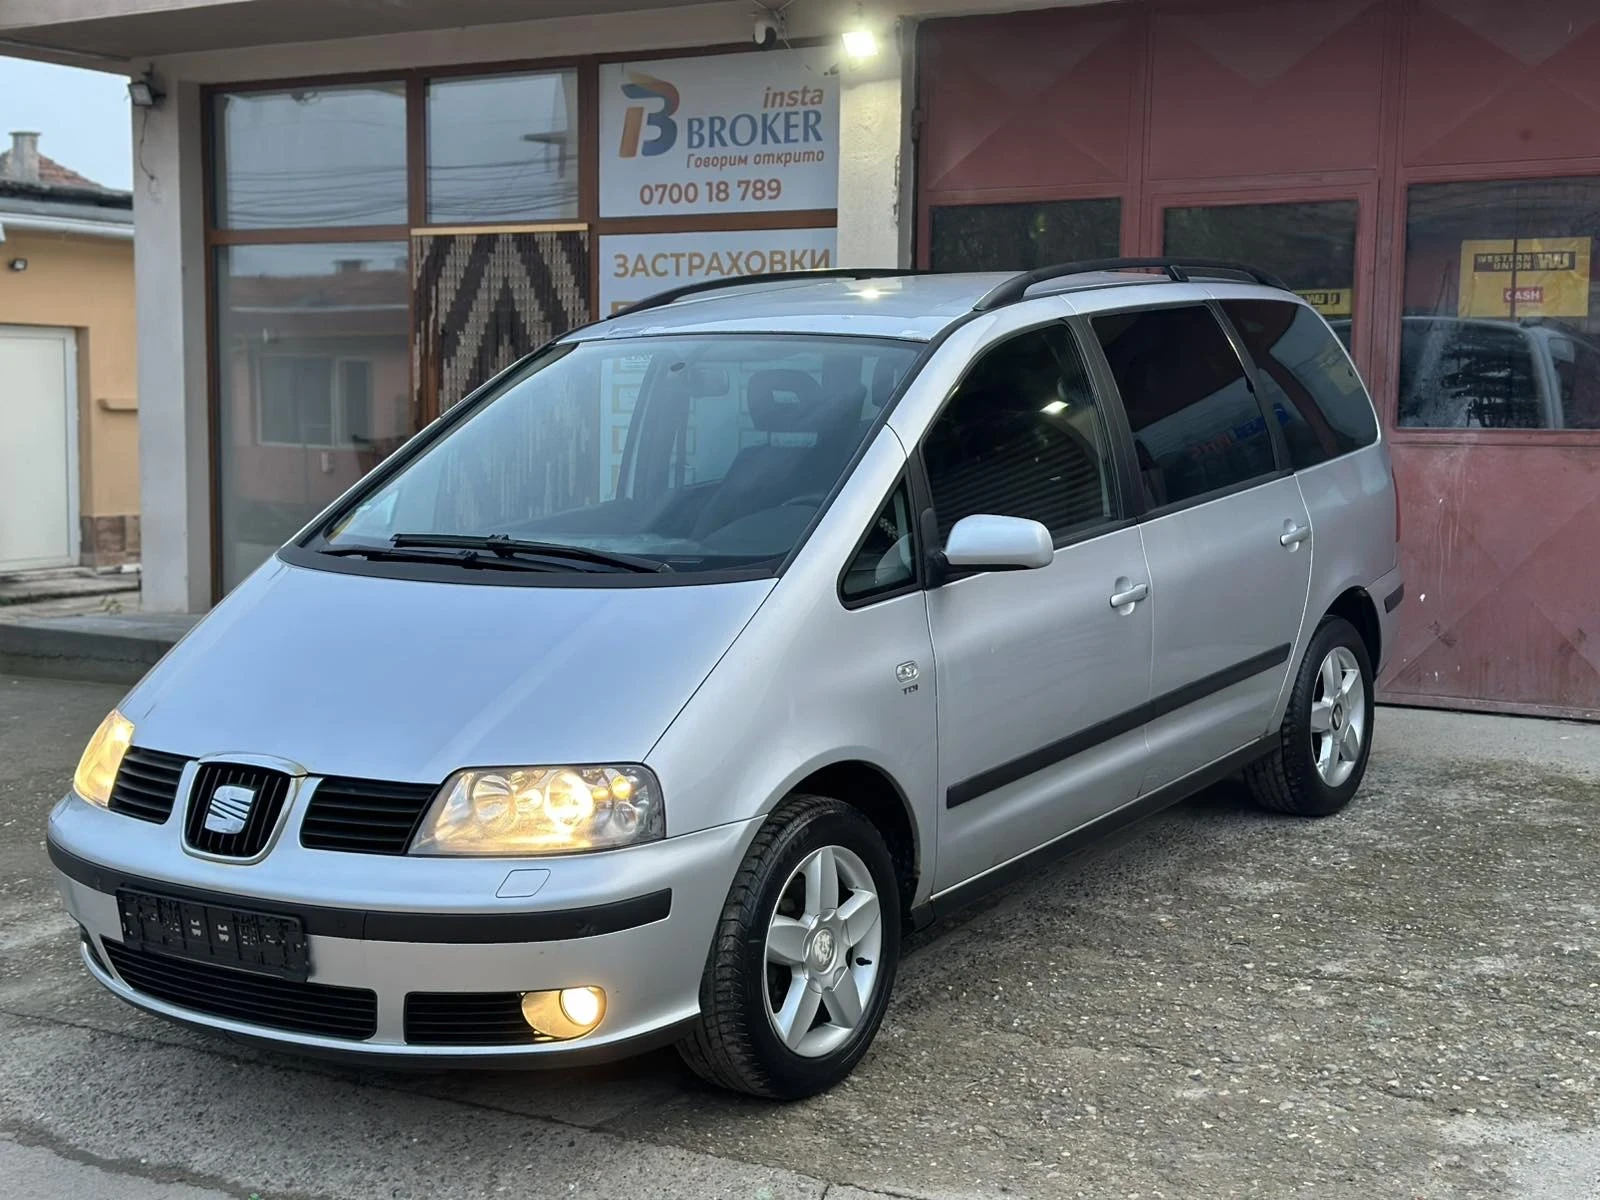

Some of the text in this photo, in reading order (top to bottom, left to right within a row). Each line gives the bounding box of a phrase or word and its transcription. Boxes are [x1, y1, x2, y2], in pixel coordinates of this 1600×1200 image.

[763, 86, 824, 108] insta
[687, 109, 823, 149] BROKER
[686, 149, 824, 170] Говорим открито
[639, 178, 782, 205] 0700 18 789
[613, 248, 831, 278] ЗАСТРАХОВКИ
[1505, 291, 1540, 301] CASH
